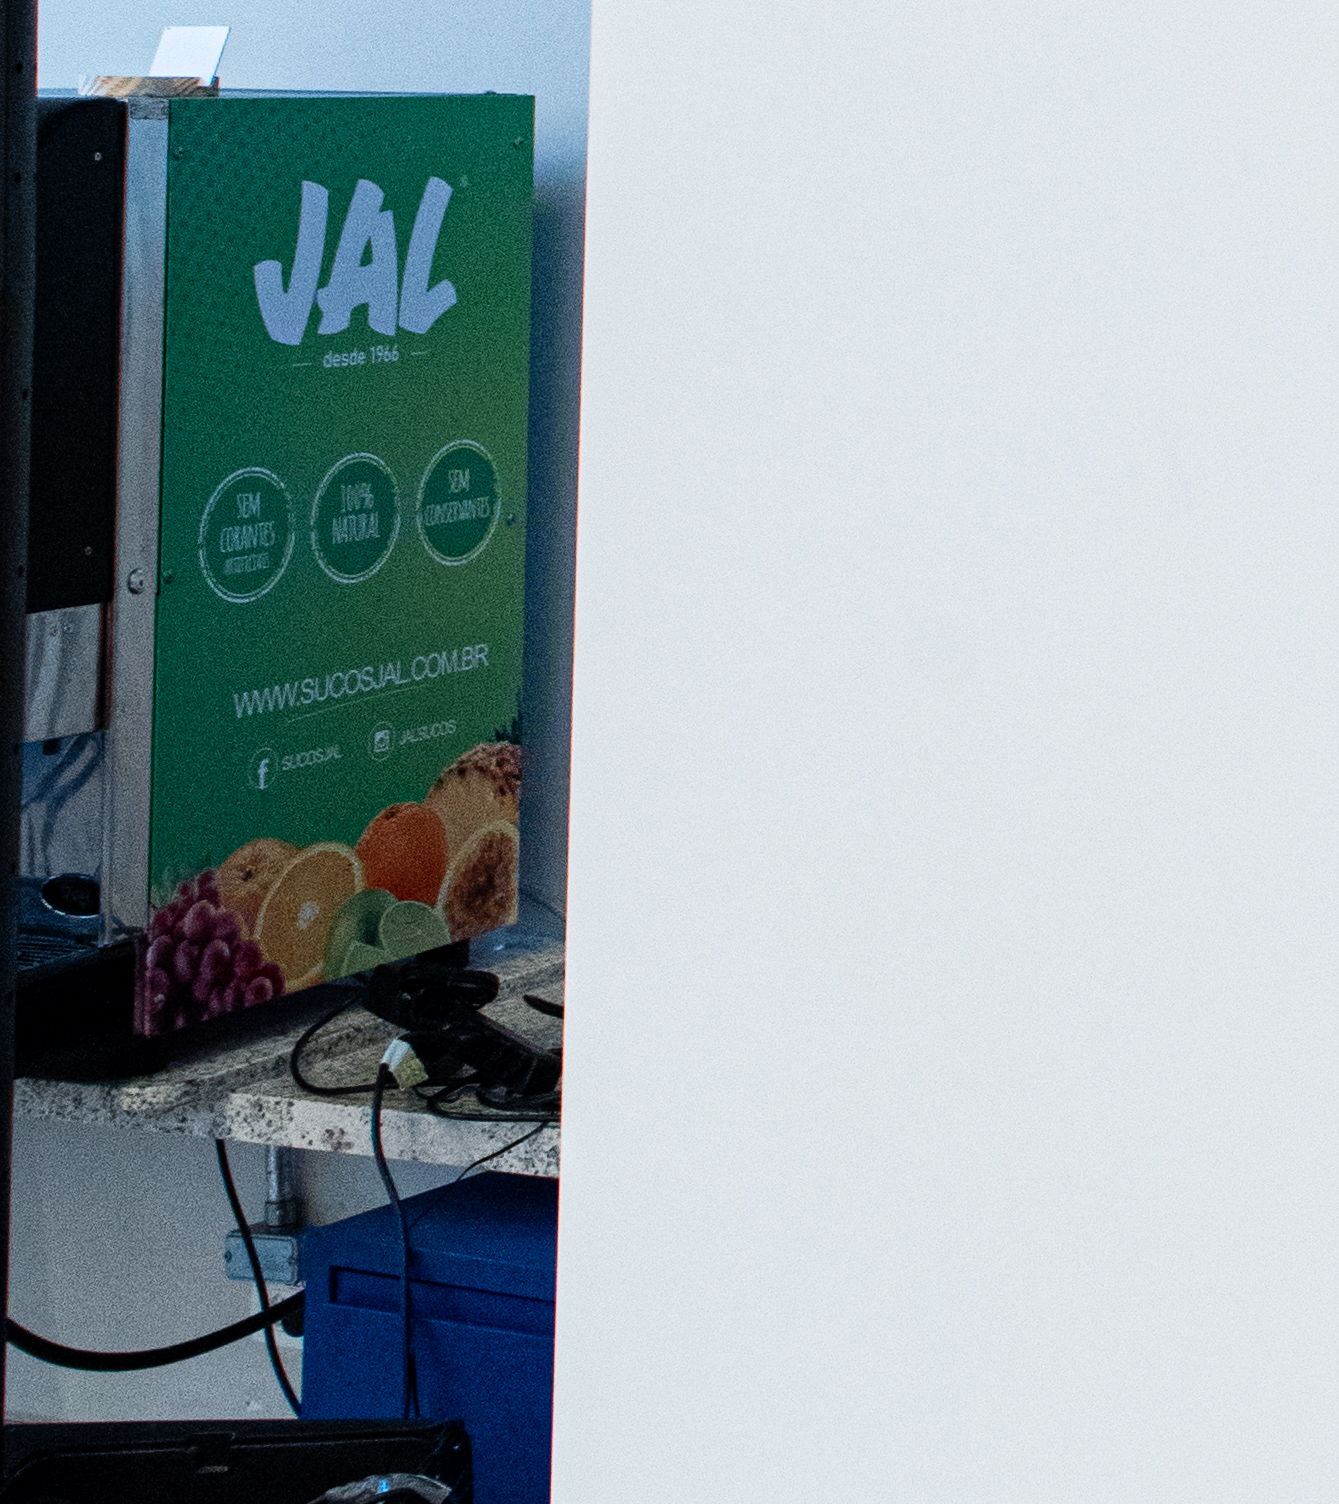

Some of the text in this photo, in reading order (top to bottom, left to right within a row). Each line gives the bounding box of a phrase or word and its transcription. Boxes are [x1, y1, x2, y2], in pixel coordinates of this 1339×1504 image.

[254, 176, 457, 346] JAL
[323, 344, 399, 368] desde 1966
[237, 492, 261, 519] SEM
